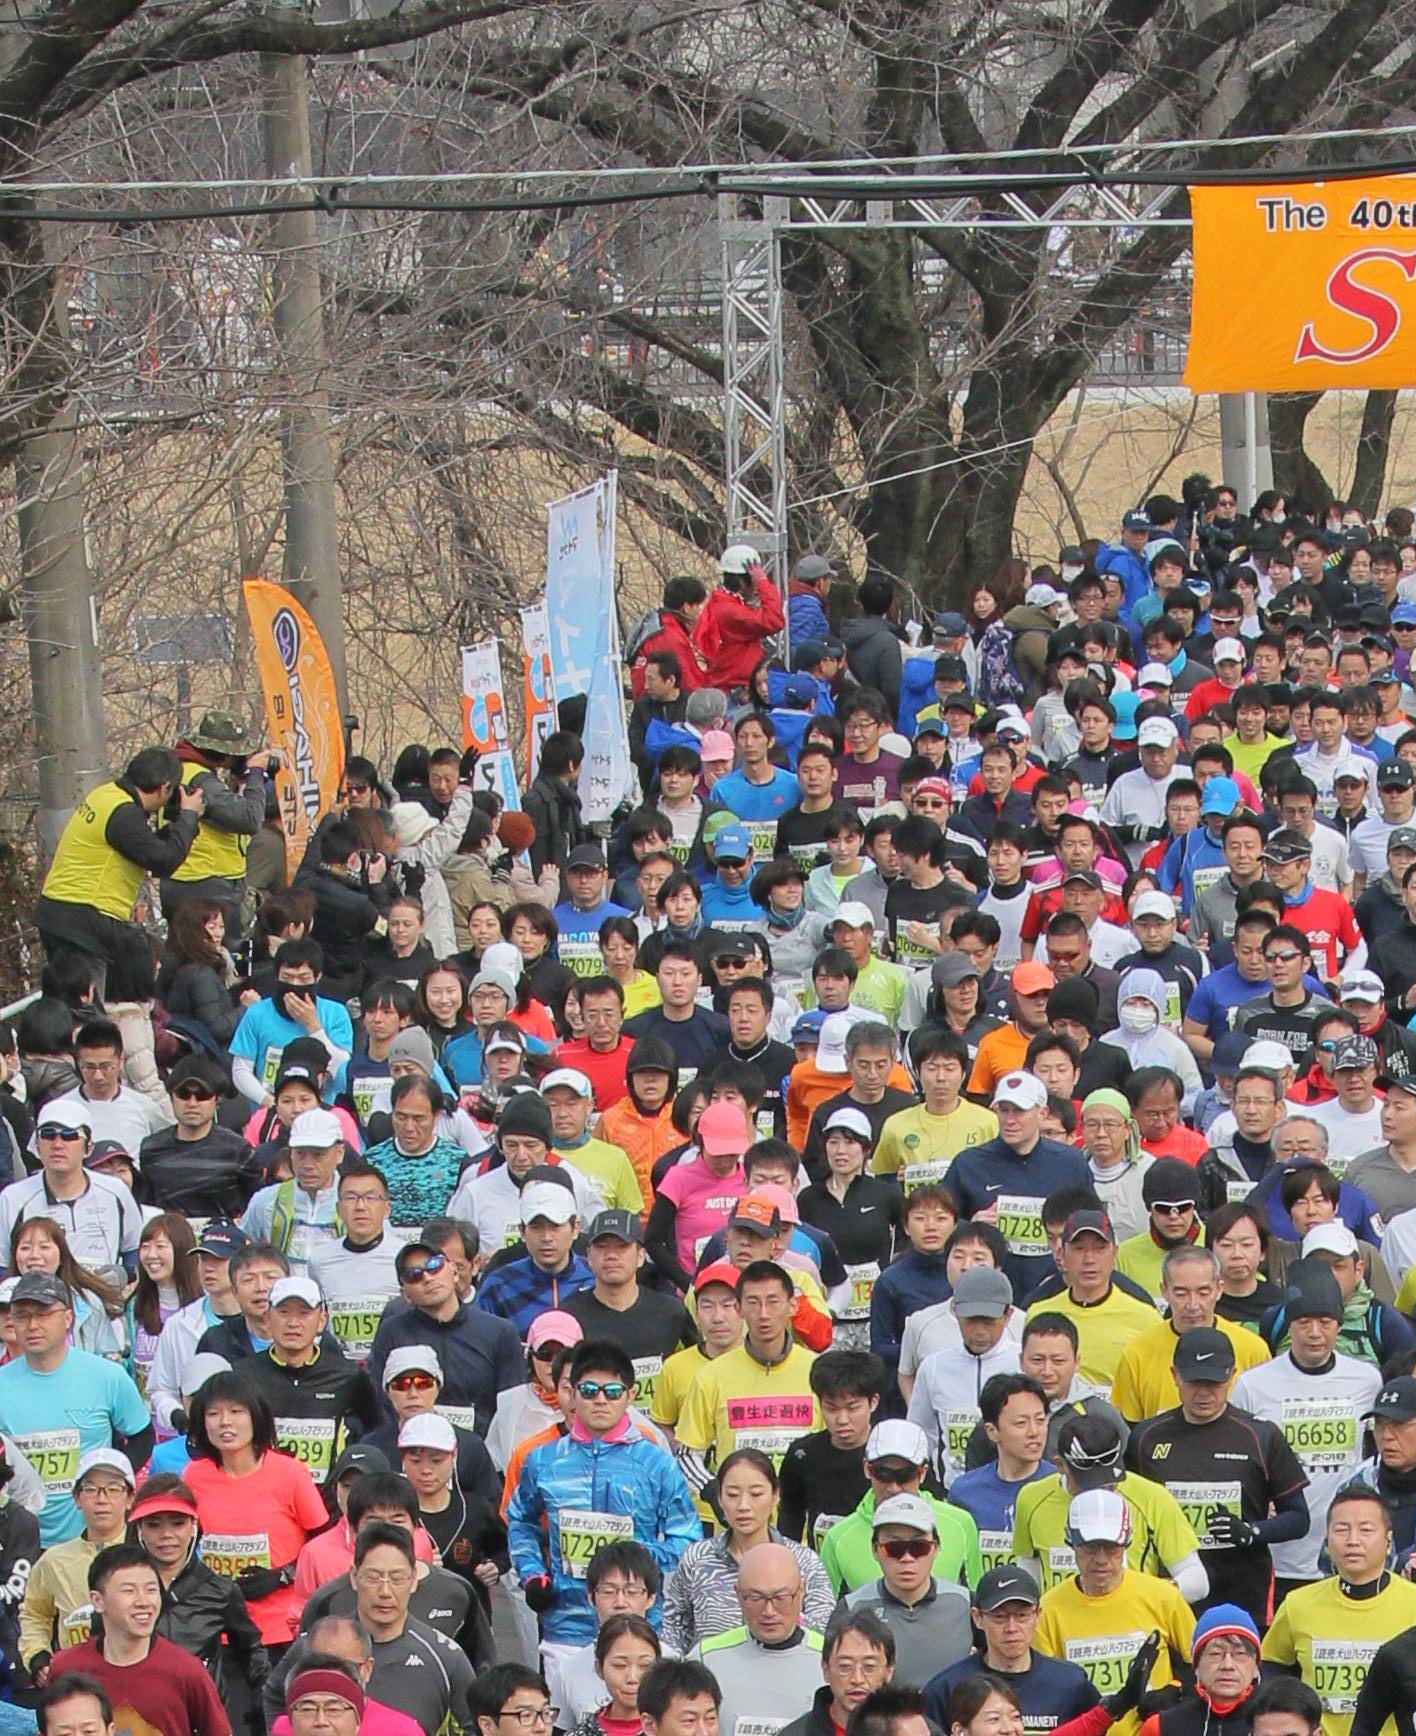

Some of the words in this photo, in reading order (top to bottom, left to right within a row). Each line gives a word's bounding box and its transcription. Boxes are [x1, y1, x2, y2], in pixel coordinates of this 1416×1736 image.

[1258, 199, 1326, 231] The
[705, 1197, 725, 1210] JUST
[998, 1215, 1043, 1238] D728
[1285, 1422, 1348, 1446] D6658
[1084, 1656, 1132, 1686] 731
[1315, 1665, 1365, 1691] D739
[1021, 1715, 1059, 1728] RMANENT
